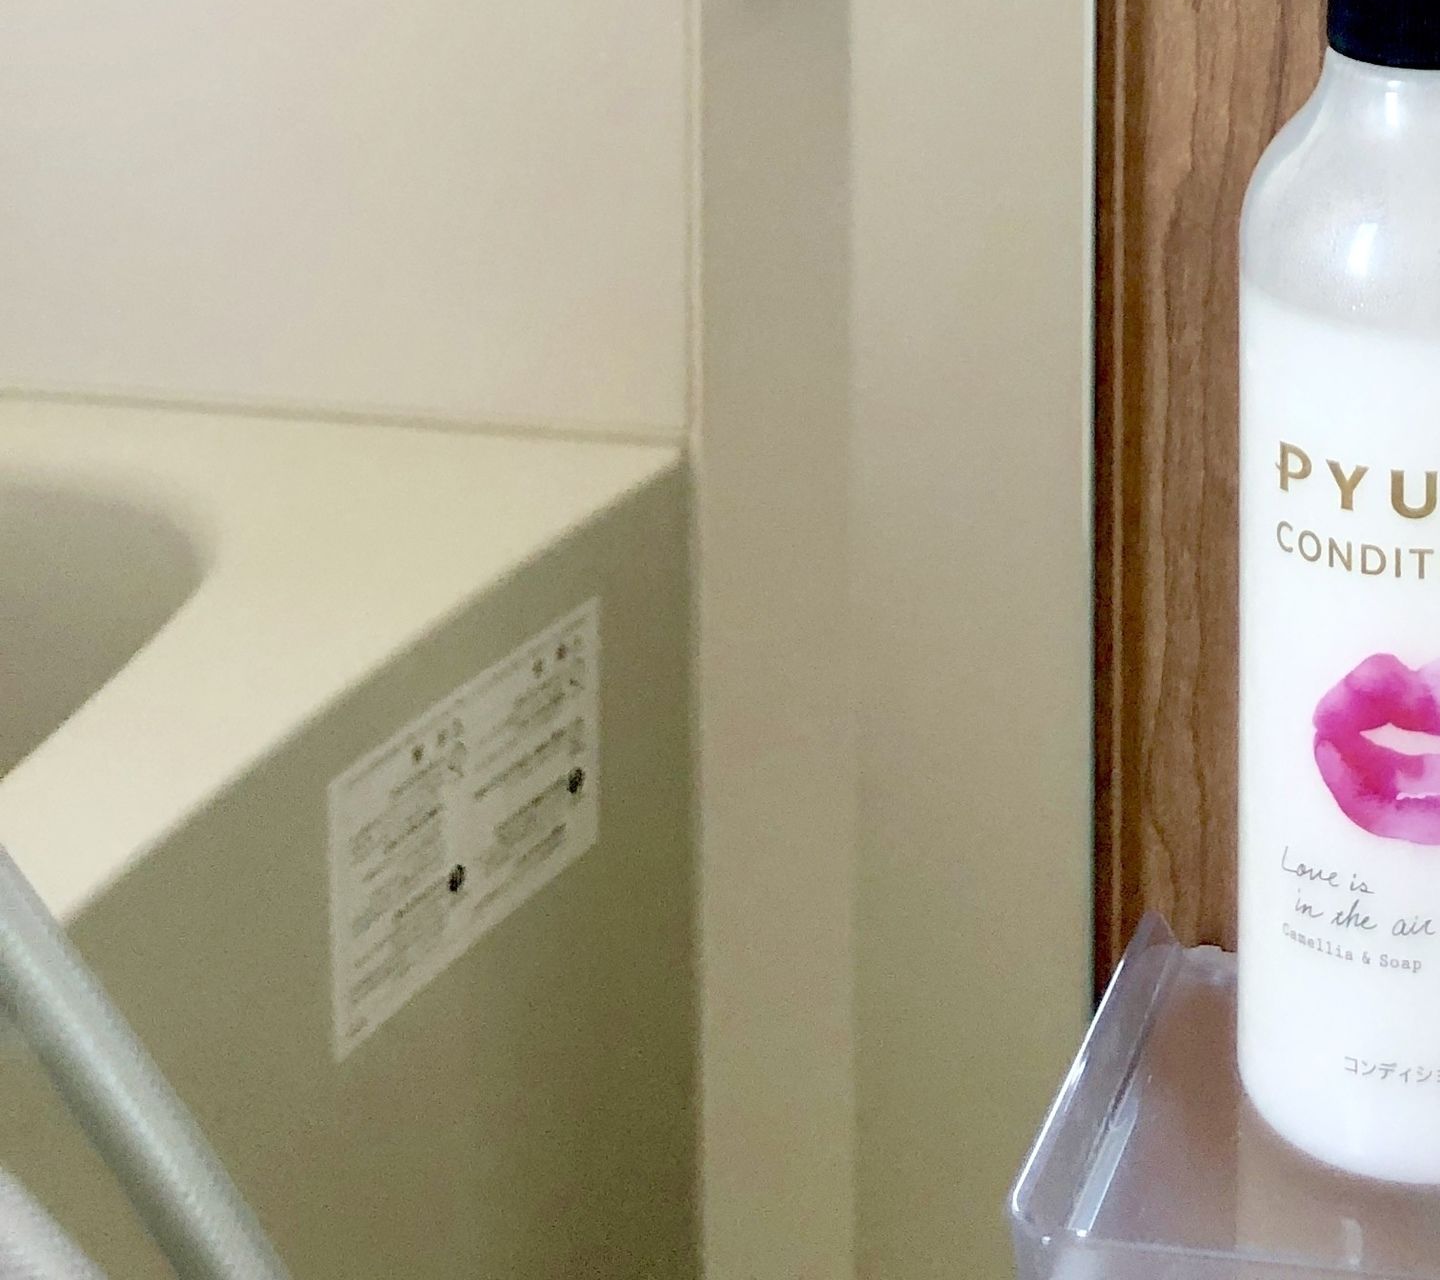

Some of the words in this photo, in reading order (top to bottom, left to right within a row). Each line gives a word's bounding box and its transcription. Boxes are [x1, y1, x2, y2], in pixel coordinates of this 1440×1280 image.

[1281, 845, 1340, 887] Love
[1350, 873, 1375, 894] is
[1295, 888, 1324, 918] in
[1331, 899, 1378, 930] the
[1392, 916, 1436, 936] air
[1282, 922, 1354, 961] Camellia
[1362, 951, 1371, 965] &
[1379, 954, 1422, 973] Soap
